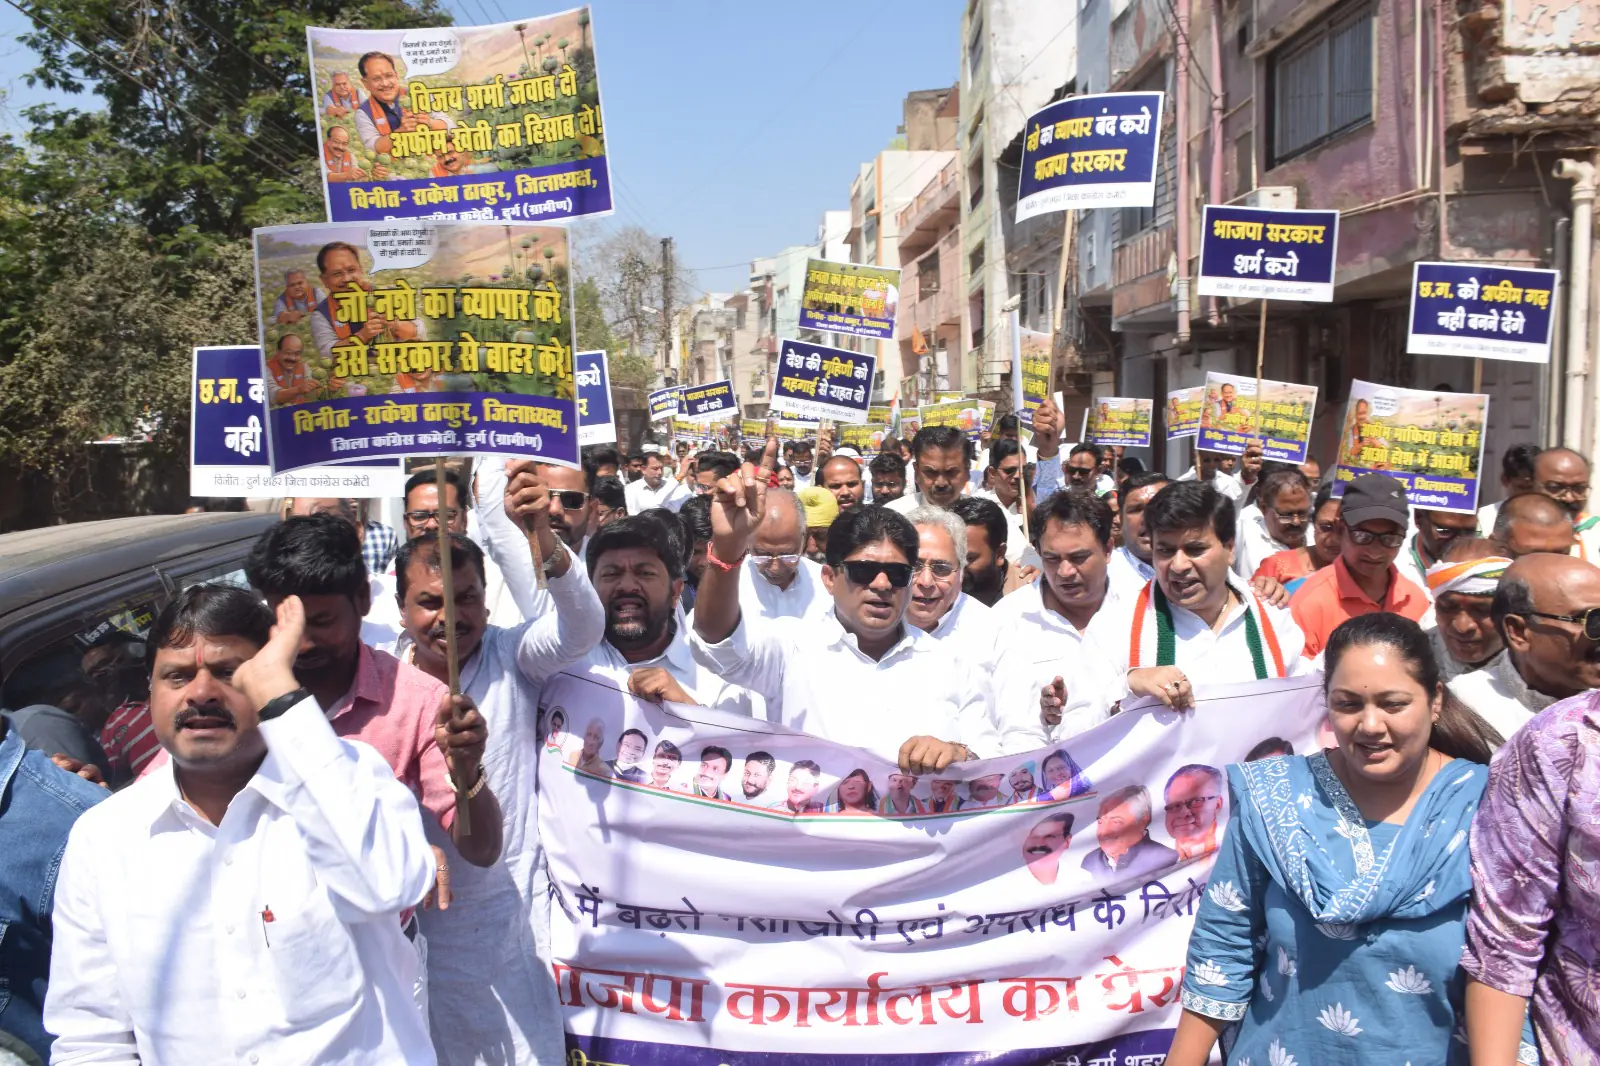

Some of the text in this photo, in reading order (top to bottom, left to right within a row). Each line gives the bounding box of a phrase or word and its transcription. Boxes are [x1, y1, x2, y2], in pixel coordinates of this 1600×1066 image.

[409, 65, 577, 114] विजय शर्मा जवाब दो
[390, 104, 604, 158] अफीम खेती का हिसाब दो!
[1040, 125, 1054, 146] का
[1054, 117, 1094, 140] व्यापार
[1095, 107, 1118, 136] बंद
[1120, 106, 1152, 135] करो
[1034, 149, 1128, 181] भाजपा सरकार
[412, 183, 459, 206] राकेश
[462, 181, 511, 206] ठाकुर,
[515, 168, 597, 196] जिलाध्यक्ष,
[523, 197, 573, 219] (ग्रामीण)
[1213, 219, 1326, 244] भाजपा सरकार
[1233, 248, 1299, 277] शर्म करो
[333, 279, 562, 324] जो नशे का व्यापार करे
[1419, 277, 1551, 310] छ.ग. को अफीम गढ़
[1437, 306, 1526, 335] नही बनने देंगे
[332, 332, 573, 382] उसे सरकार से बाहर करे!
[786, 348, 869, 380] देश की गृहिणी को
[198, 378, 266, 404] छ.ग. क
[782, 373, 866, 403] महंगाई से राहत दो
[364, 400, 418, 425] राकेश
[422, 402, 478, 428] ठाकुर,
[482, 398, 568, 434] जिलाध्यक्ष,
[224, 415, 262, 457] नही
[331, 430, 543, 452] जिला कांग्रेस कमेटी, दुर्ग (ग्रामीण)
[1361, 421, 1480, 448] अफीम माफिया होश में
[1360, 445, 1388, 462] आओ
[1390, 446, 1415, 466] होश
[1417, 448, 1429, 467] में
[263, 475, 282, 487] शहर
[285, 474, 308, 487] जिला
[310, 474, 340, 488] कांग्रेस
[342, 475, 370, 487] कमेटी
[574, 882, 603, 928] में
[615, 896, 704, 939] बढ़ते
[896, 903, 948, 945] एवं
[962, 900, 1080, 935] अपराध
[1092, 888, 1126, 930] के
[724, 970, 985, 1028] कार्यालय
[998, 975, 1082, 1022] का
